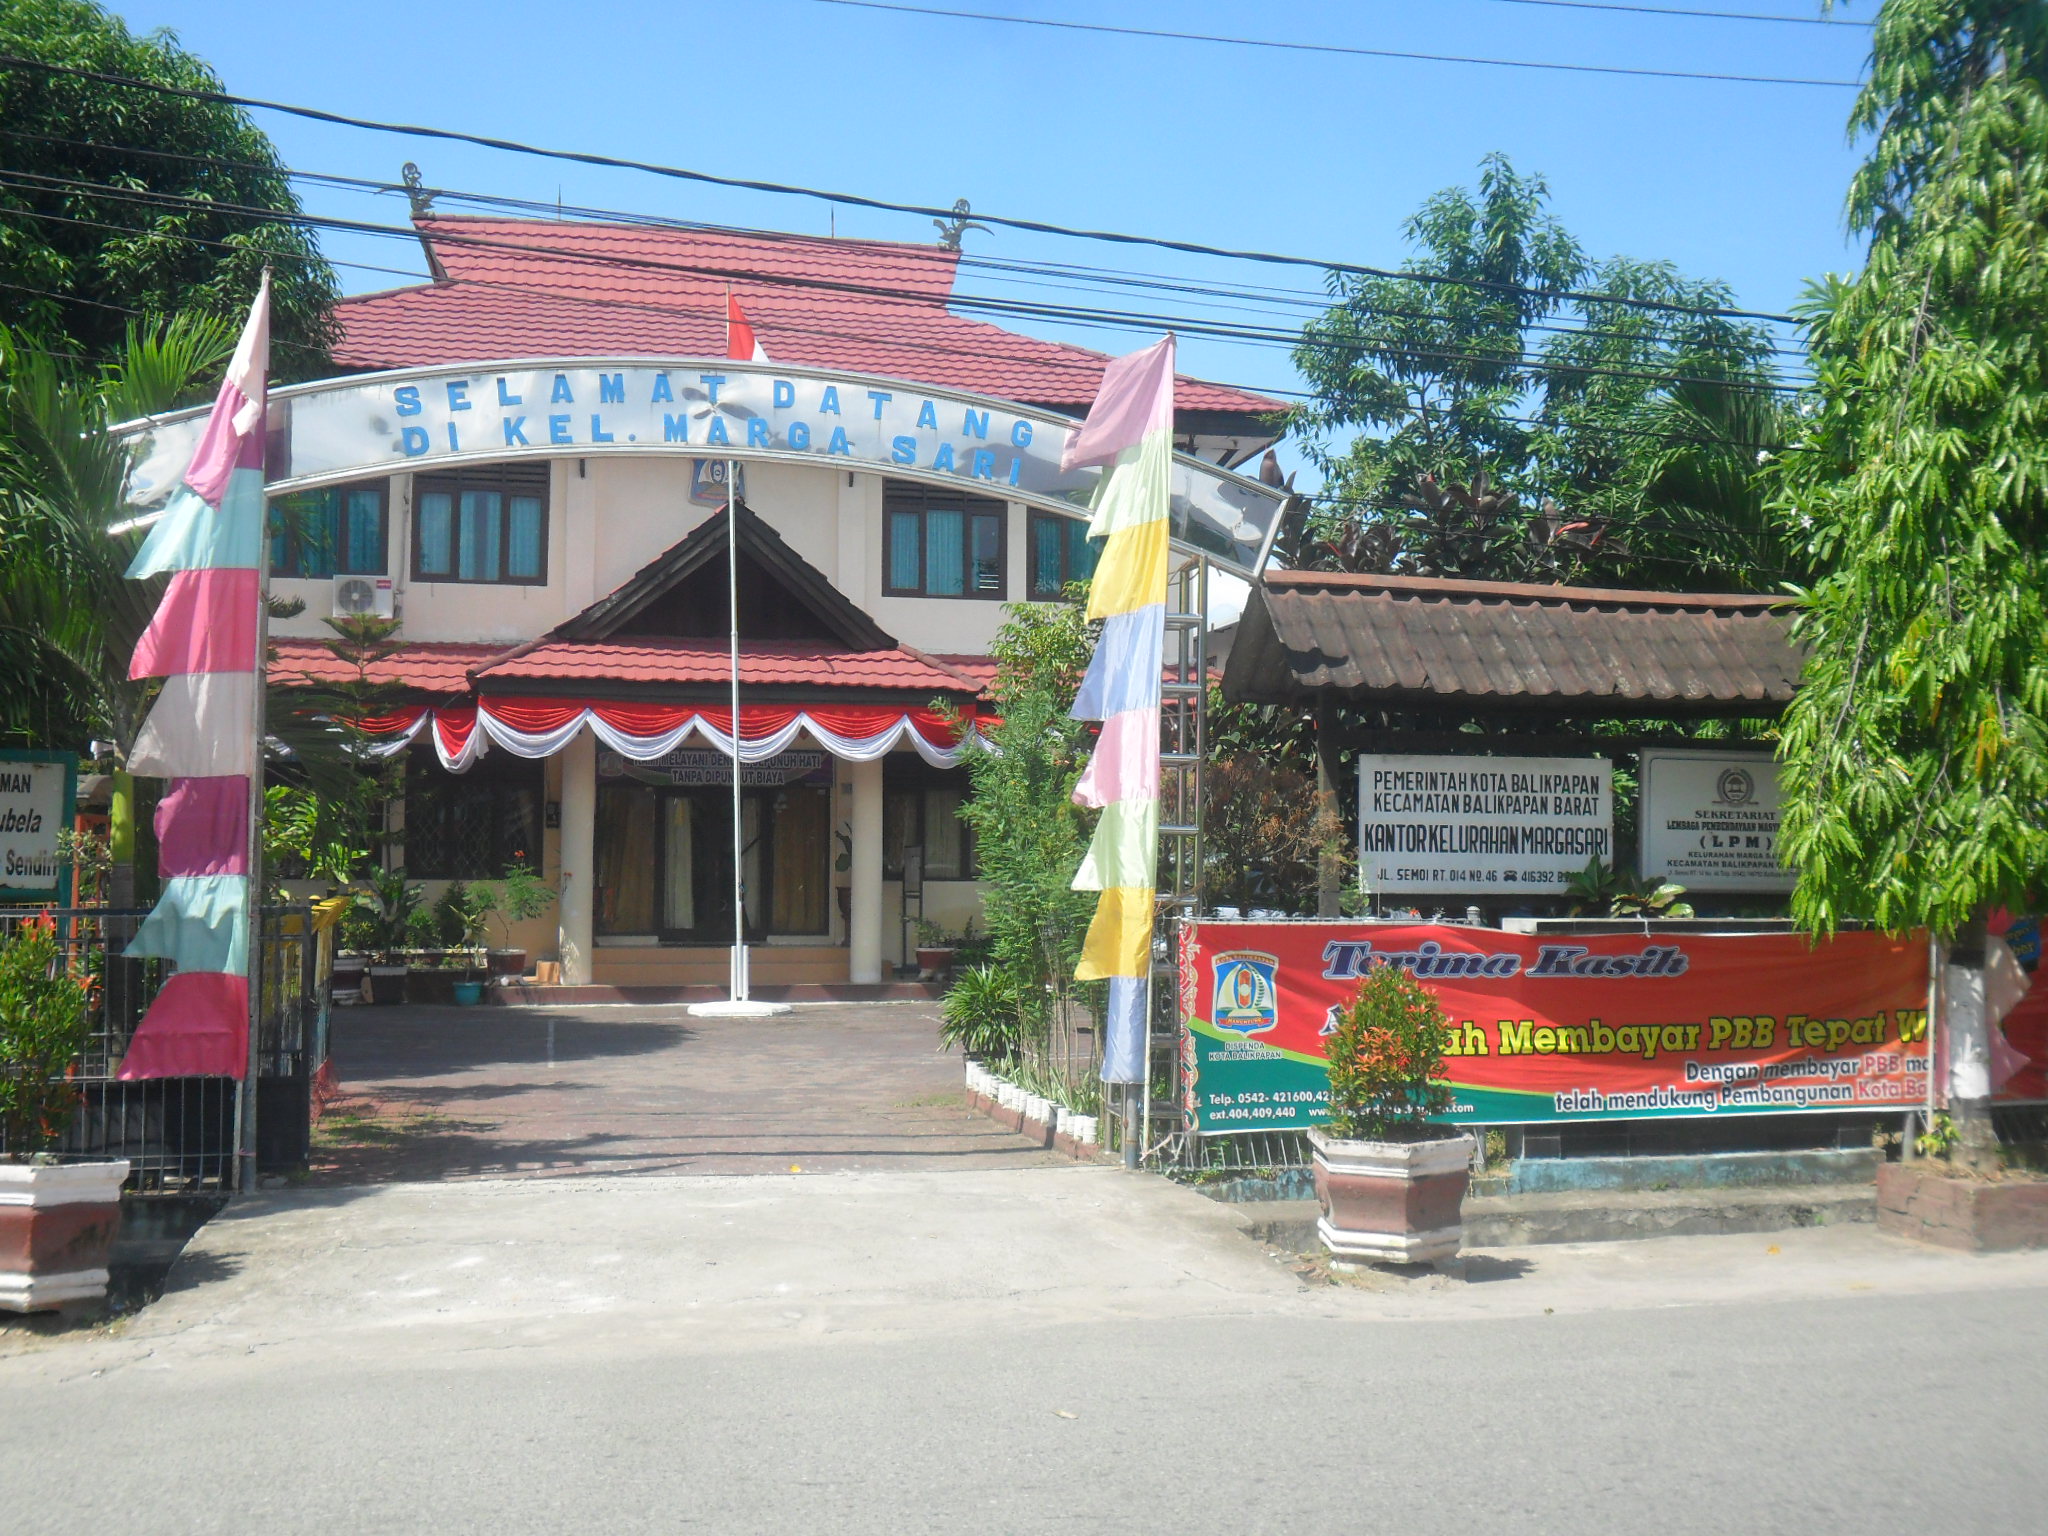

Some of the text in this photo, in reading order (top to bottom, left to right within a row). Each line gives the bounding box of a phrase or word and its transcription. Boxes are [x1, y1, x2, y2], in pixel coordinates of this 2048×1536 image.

[394, 372, 1033, 448] SELAMAT DATANG
[400, 413, 1021, 487] DI KEL. MARGA SARI
[661, 753, 708, 767] MELAYANI
[799, 754, 820, 768] HATI
[672, 770, 784, 784] TANPA DIPUNUT BIAYA
[1374, 771, 1600, 795] PEMERINTAH KOTA BALIKPAPAN
[1374, 793, 1599, 816] KECAMATAN BALIKPAPAN BARAT
[1695, 810, 1776, 821] SEKRETARIAT
[1667, 820, 1700, 831] LEMBAGA
[1364, 824, 1608, 856] KANTOR KELURAHAN MARGASARI
[1737, 852, 1764, 860] MARGA
[1667, 860, 1719, 868] KECAMATAN
[1722, 861, 1774, 869] BALIKPAPAN
[1378, 868, 1394, 881] JL.
[1397, 869, 1429, 882] SEMOI
[1450, 869, 1466, 882] 014
[1521, 870, 1554, 883] 416392
[1322, 940, 1689, 979] Terima Kasih
[1497, 1016, 1701, 1060] Membayar
[1708, 1015, 1776, 1050] PBB
[1785, 1011, 1887, 1052] Tepat
[1224, 1042, 1265, 1051] DISPENDA
[1209, 1051, 1281, 1061] KOTA BALIKPAPAN
[1686, 1061, 1759, 1084] Dengan
[1764, 1056, 1860, 1080] membayar
[1864, 1055, 1899, 1073] PBB
[1209, 1093, 1235, 1106] Telp.
[1556, 1089, 1601, 1111] telah
[1608, 1086, 1715, 1111] mendukung
[1722, 1083, 1852, 1106] Pembangunan
[1858, 1080, 1900, 1098] Kota
[1209, 1107, 1296, 1120] ext.404,409,440
